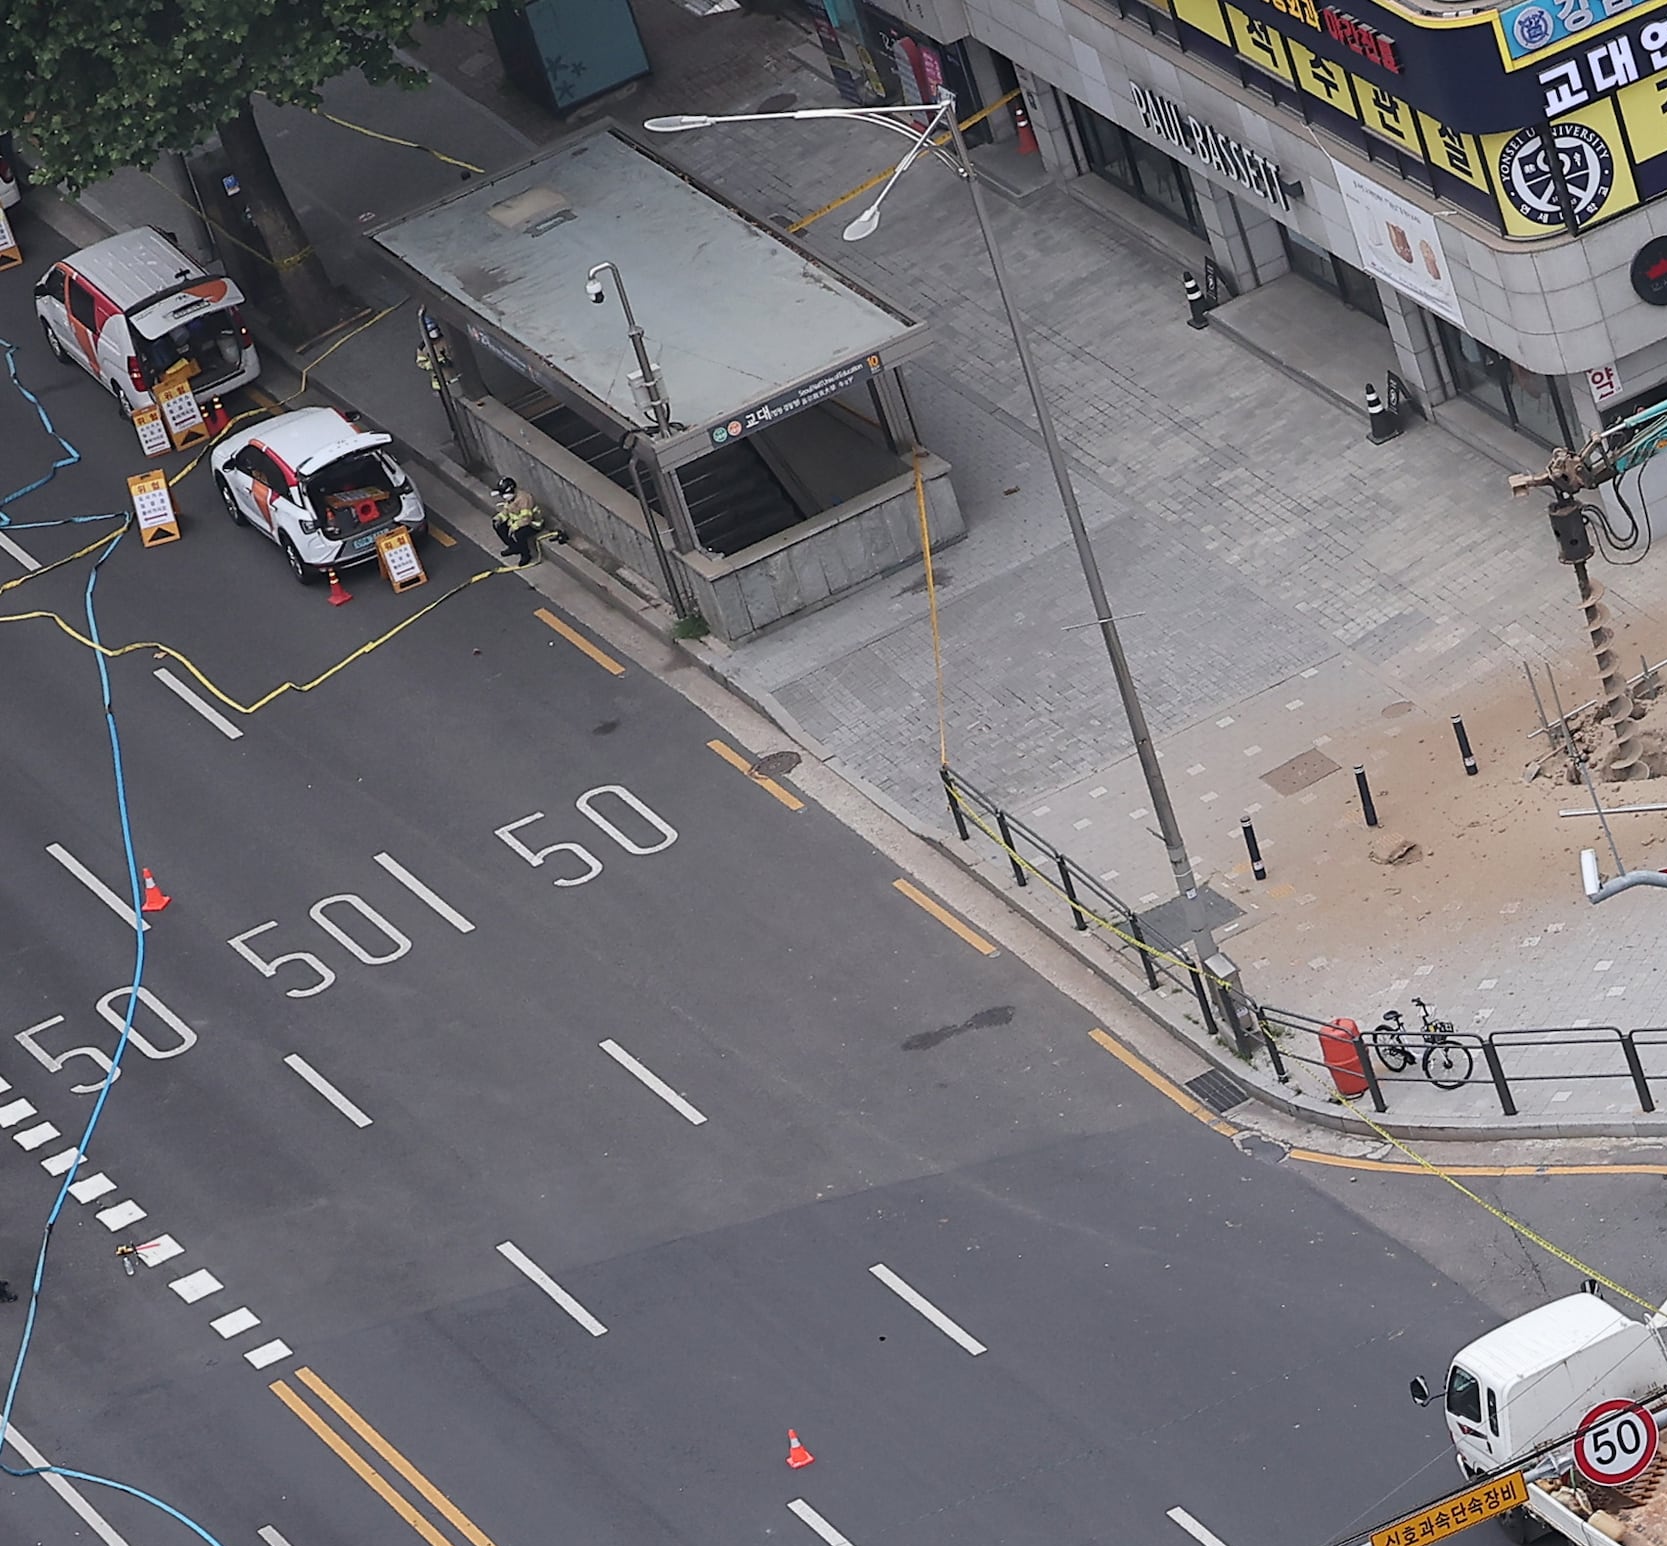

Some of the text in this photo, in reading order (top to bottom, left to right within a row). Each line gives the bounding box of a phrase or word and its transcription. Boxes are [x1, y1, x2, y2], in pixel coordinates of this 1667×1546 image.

[1129, 80, 1196, 156] PAUL
[1186, 114, 1291, 212] BASSETT
[1501, 136, 1524, 182] YONSEI
[866, 354, 879, 369] 10
[745, 404, 772, 429] 교대
[494, 784, 679, 888] 50
[227, 893, 412, 999] 50
[13, 985, 197, 1094] 50
[1591, 1418, 1642, 1466] 50
